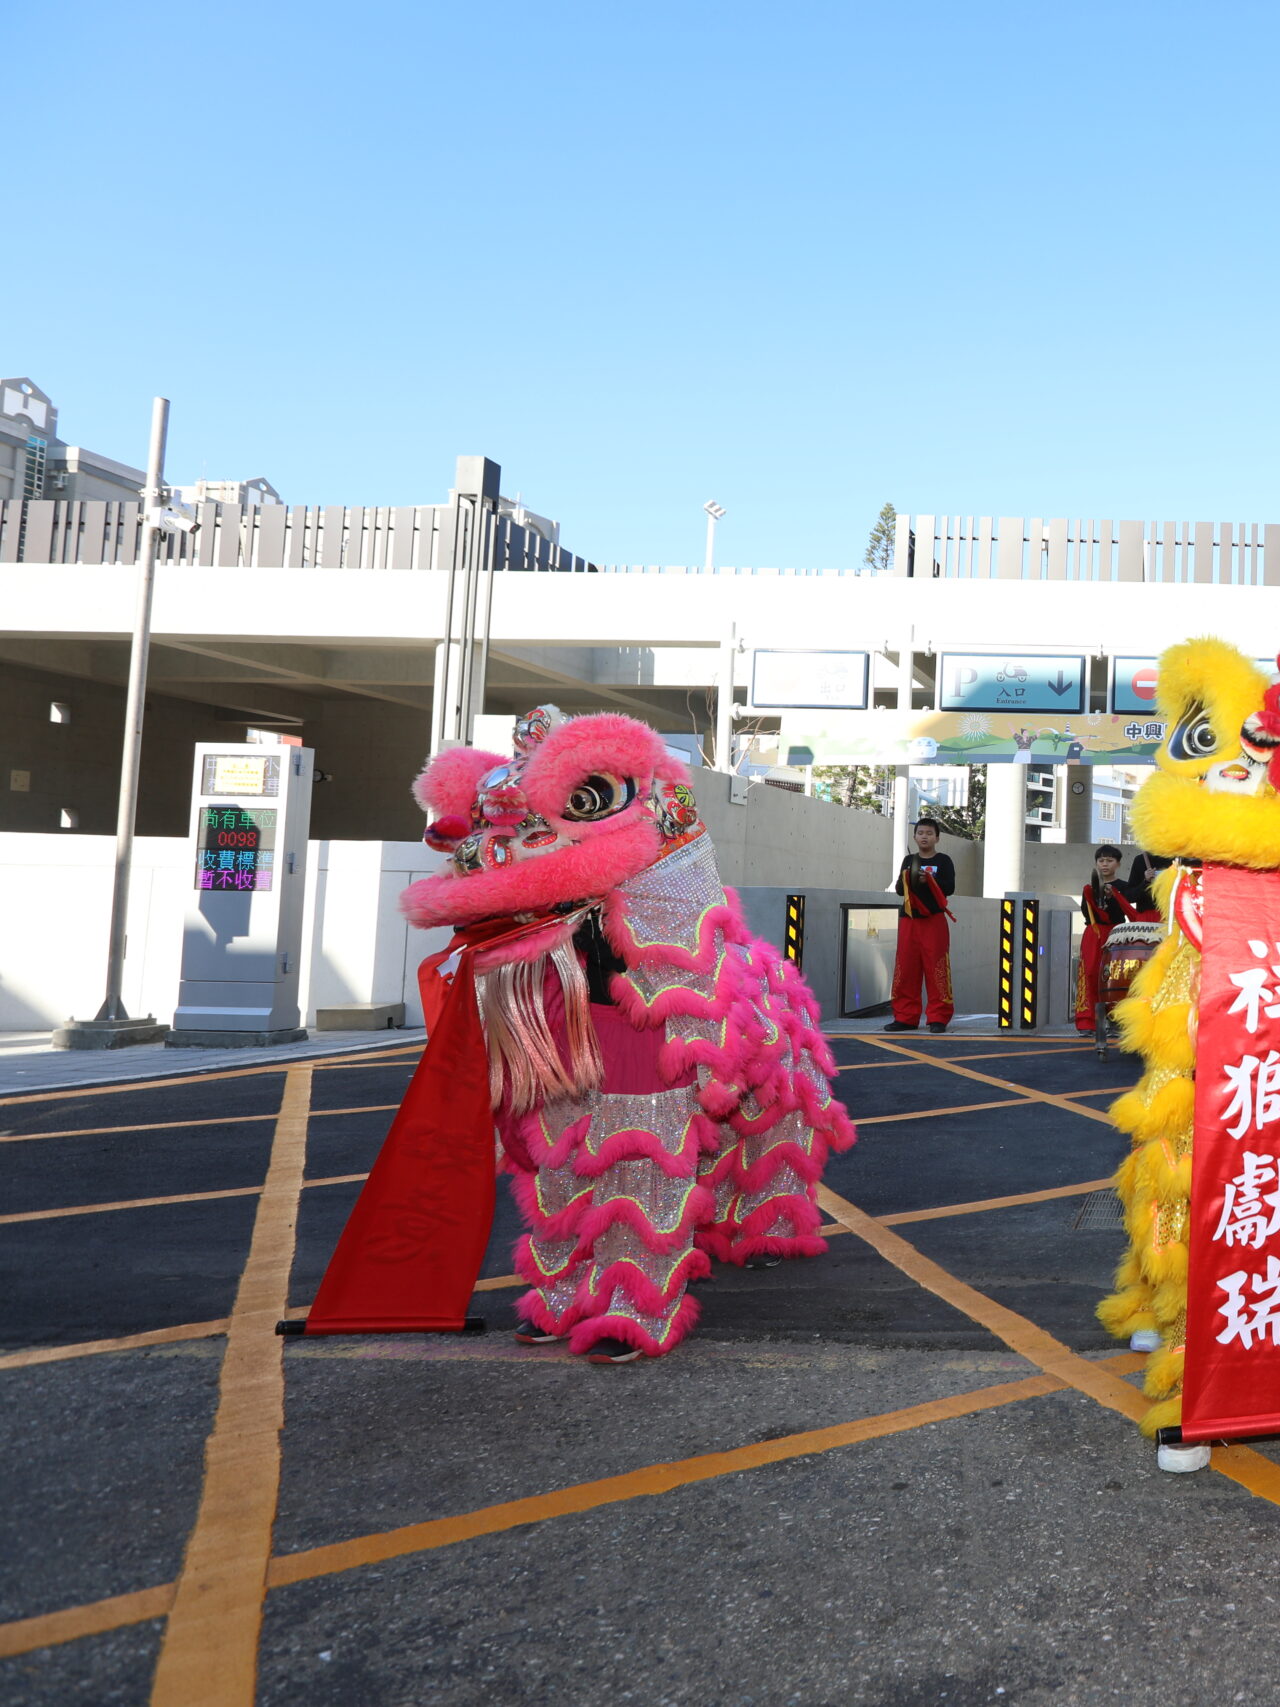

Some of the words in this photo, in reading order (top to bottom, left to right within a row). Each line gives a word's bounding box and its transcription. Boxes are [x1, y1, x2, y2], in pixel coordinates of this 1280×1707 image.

[950, 667, 978, 698] P
[998, 687, 1026, 698] 入口
[996, 697, 1027, 705] Entrance
[1124, 721, 1168, 740] 中興
[202, 808, 276, 829] 尚有車位
[218, 831, 256, 847] 0098
[198, 849, 275, 870] 收費標準
[196, 869, 272, 890] 暫不收費
